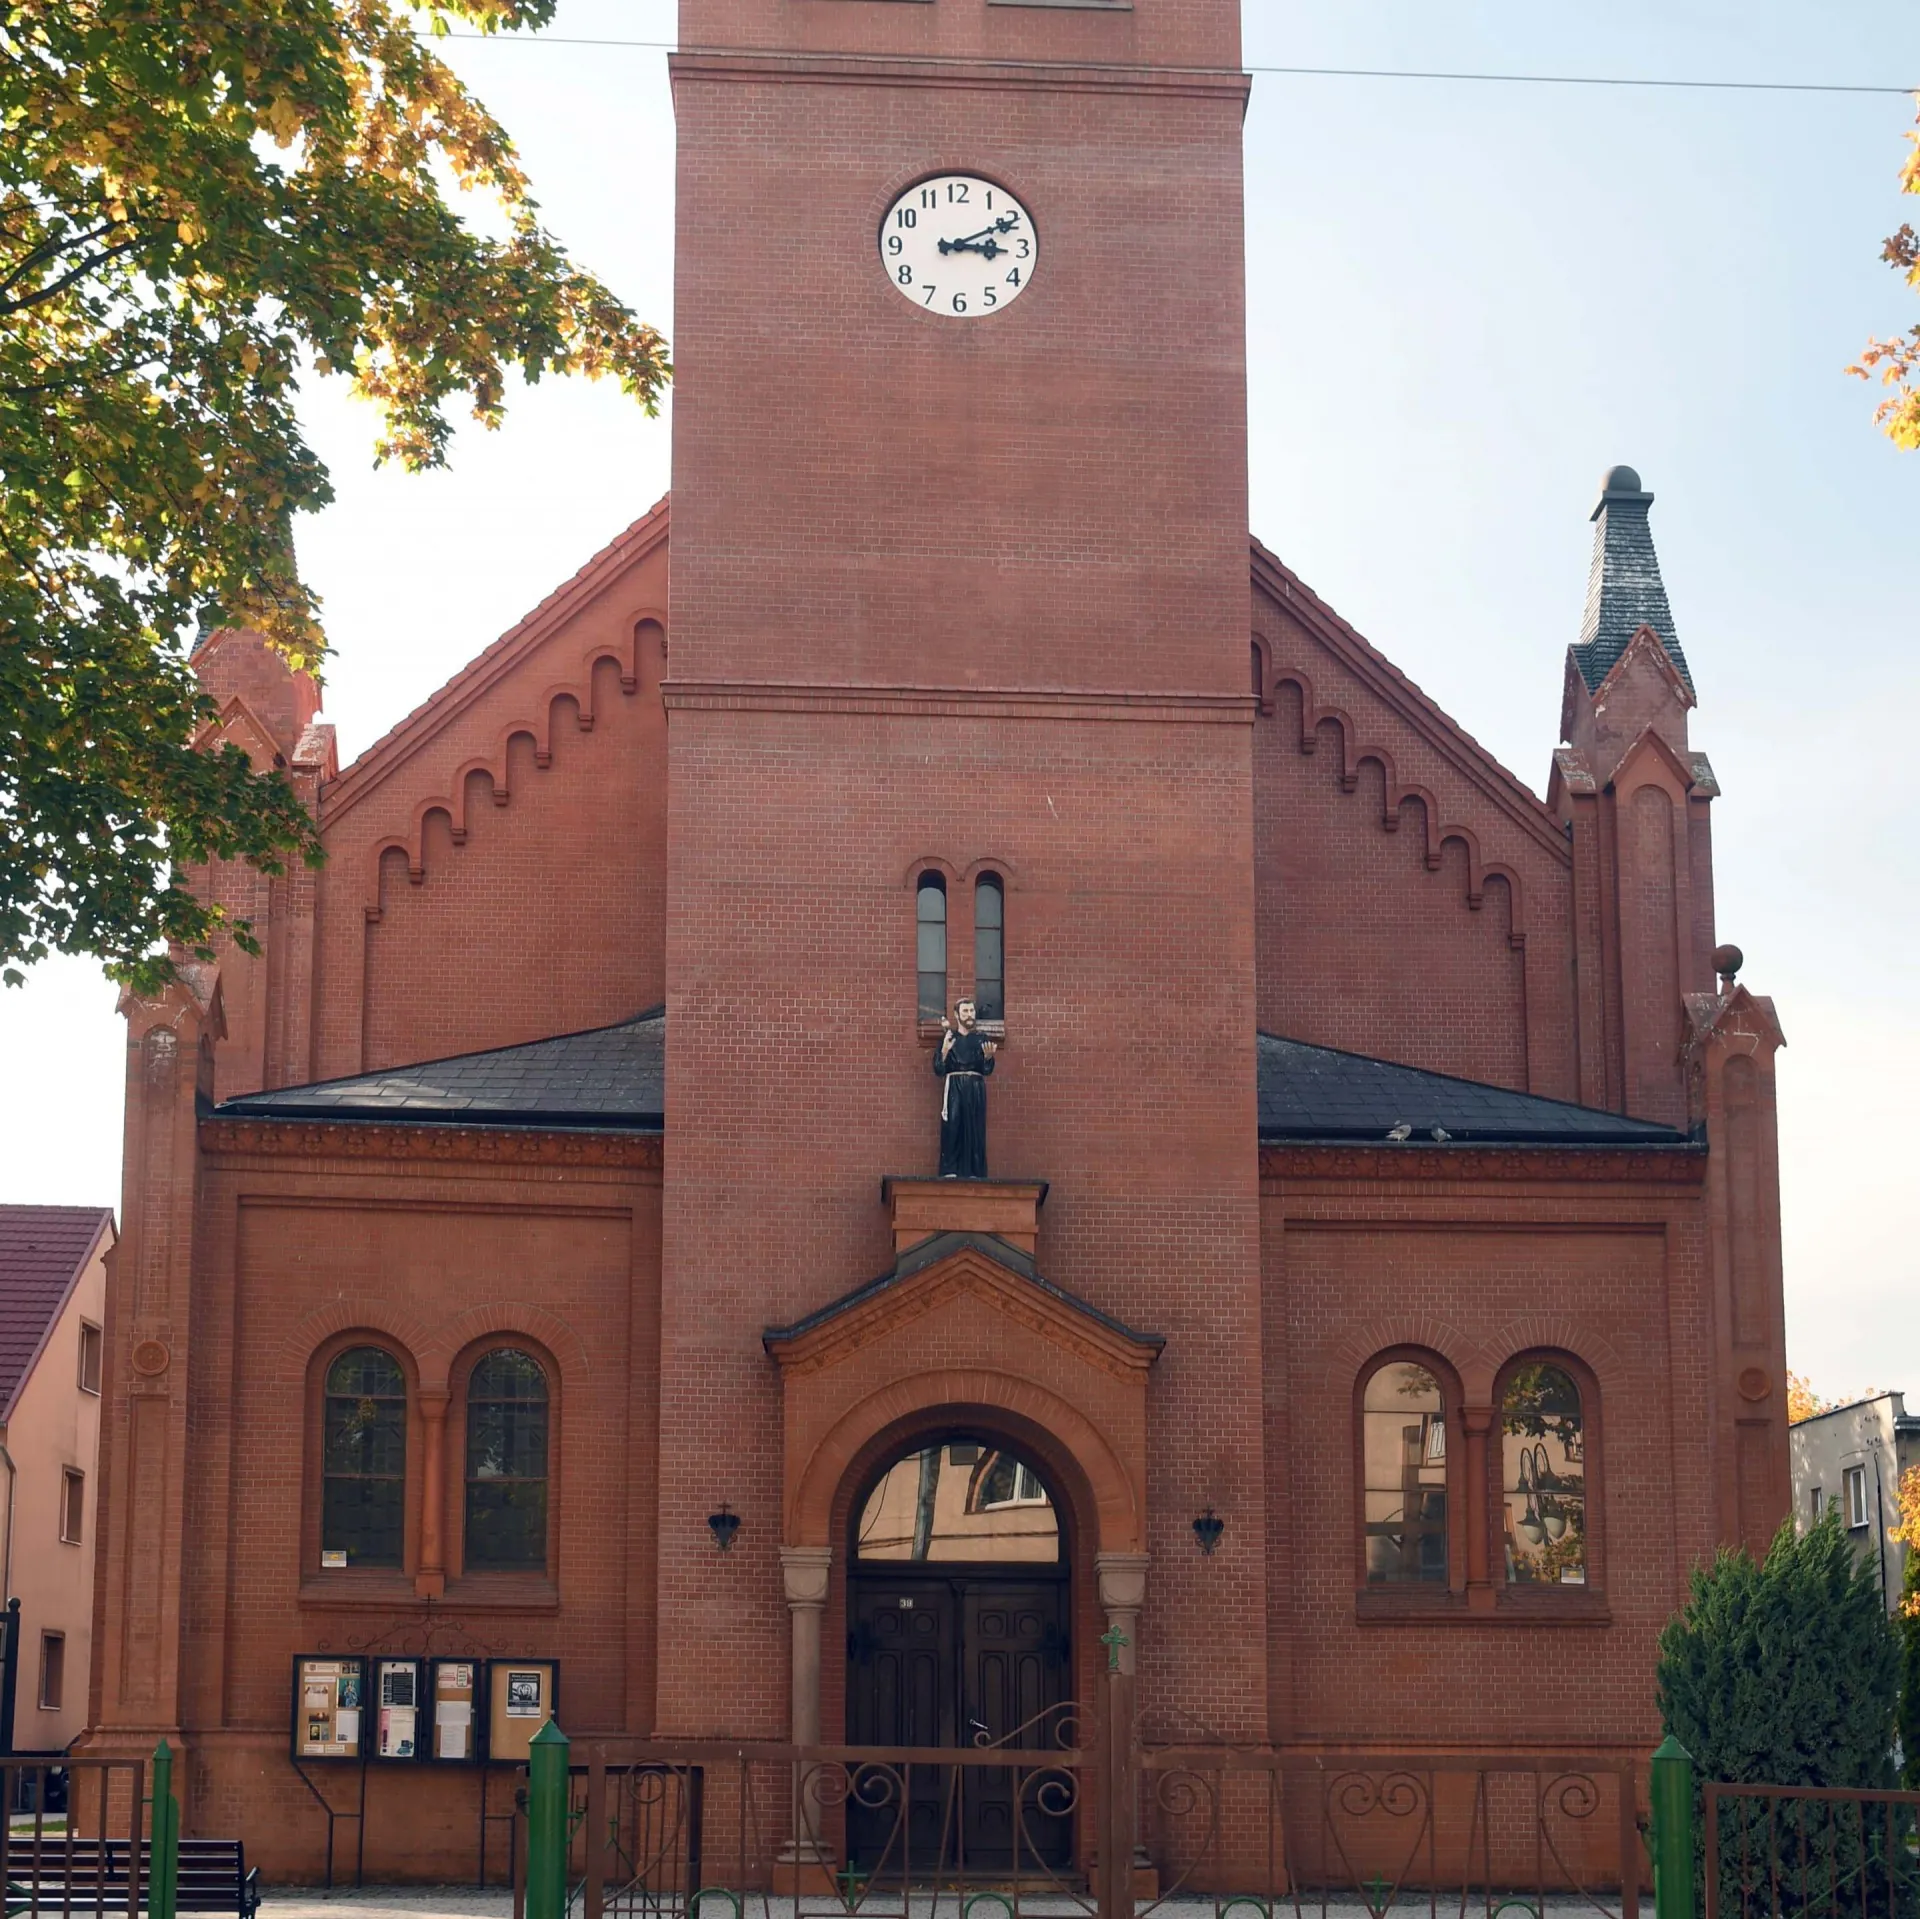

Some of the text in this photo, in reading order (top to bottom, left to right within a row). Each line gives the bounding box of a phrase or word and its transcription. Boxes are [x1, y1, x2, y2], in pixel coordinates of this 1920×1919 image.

[920, 188, 937, 209] 11
[948, 183, 970, 203] 12
[985, 190, 993, 210] 1
[897, 208, 917, 228] 10
[888, 235, 903, 256] 9
[1015, 238, 1030, 259] 3
[898, 264, 913, 285] 8
[1005, 267, 1021, 287] 4
[922, 285, 936, 305] 7
[952, 292, 967, 313] 6
[983, 286, 997, 306] 5
